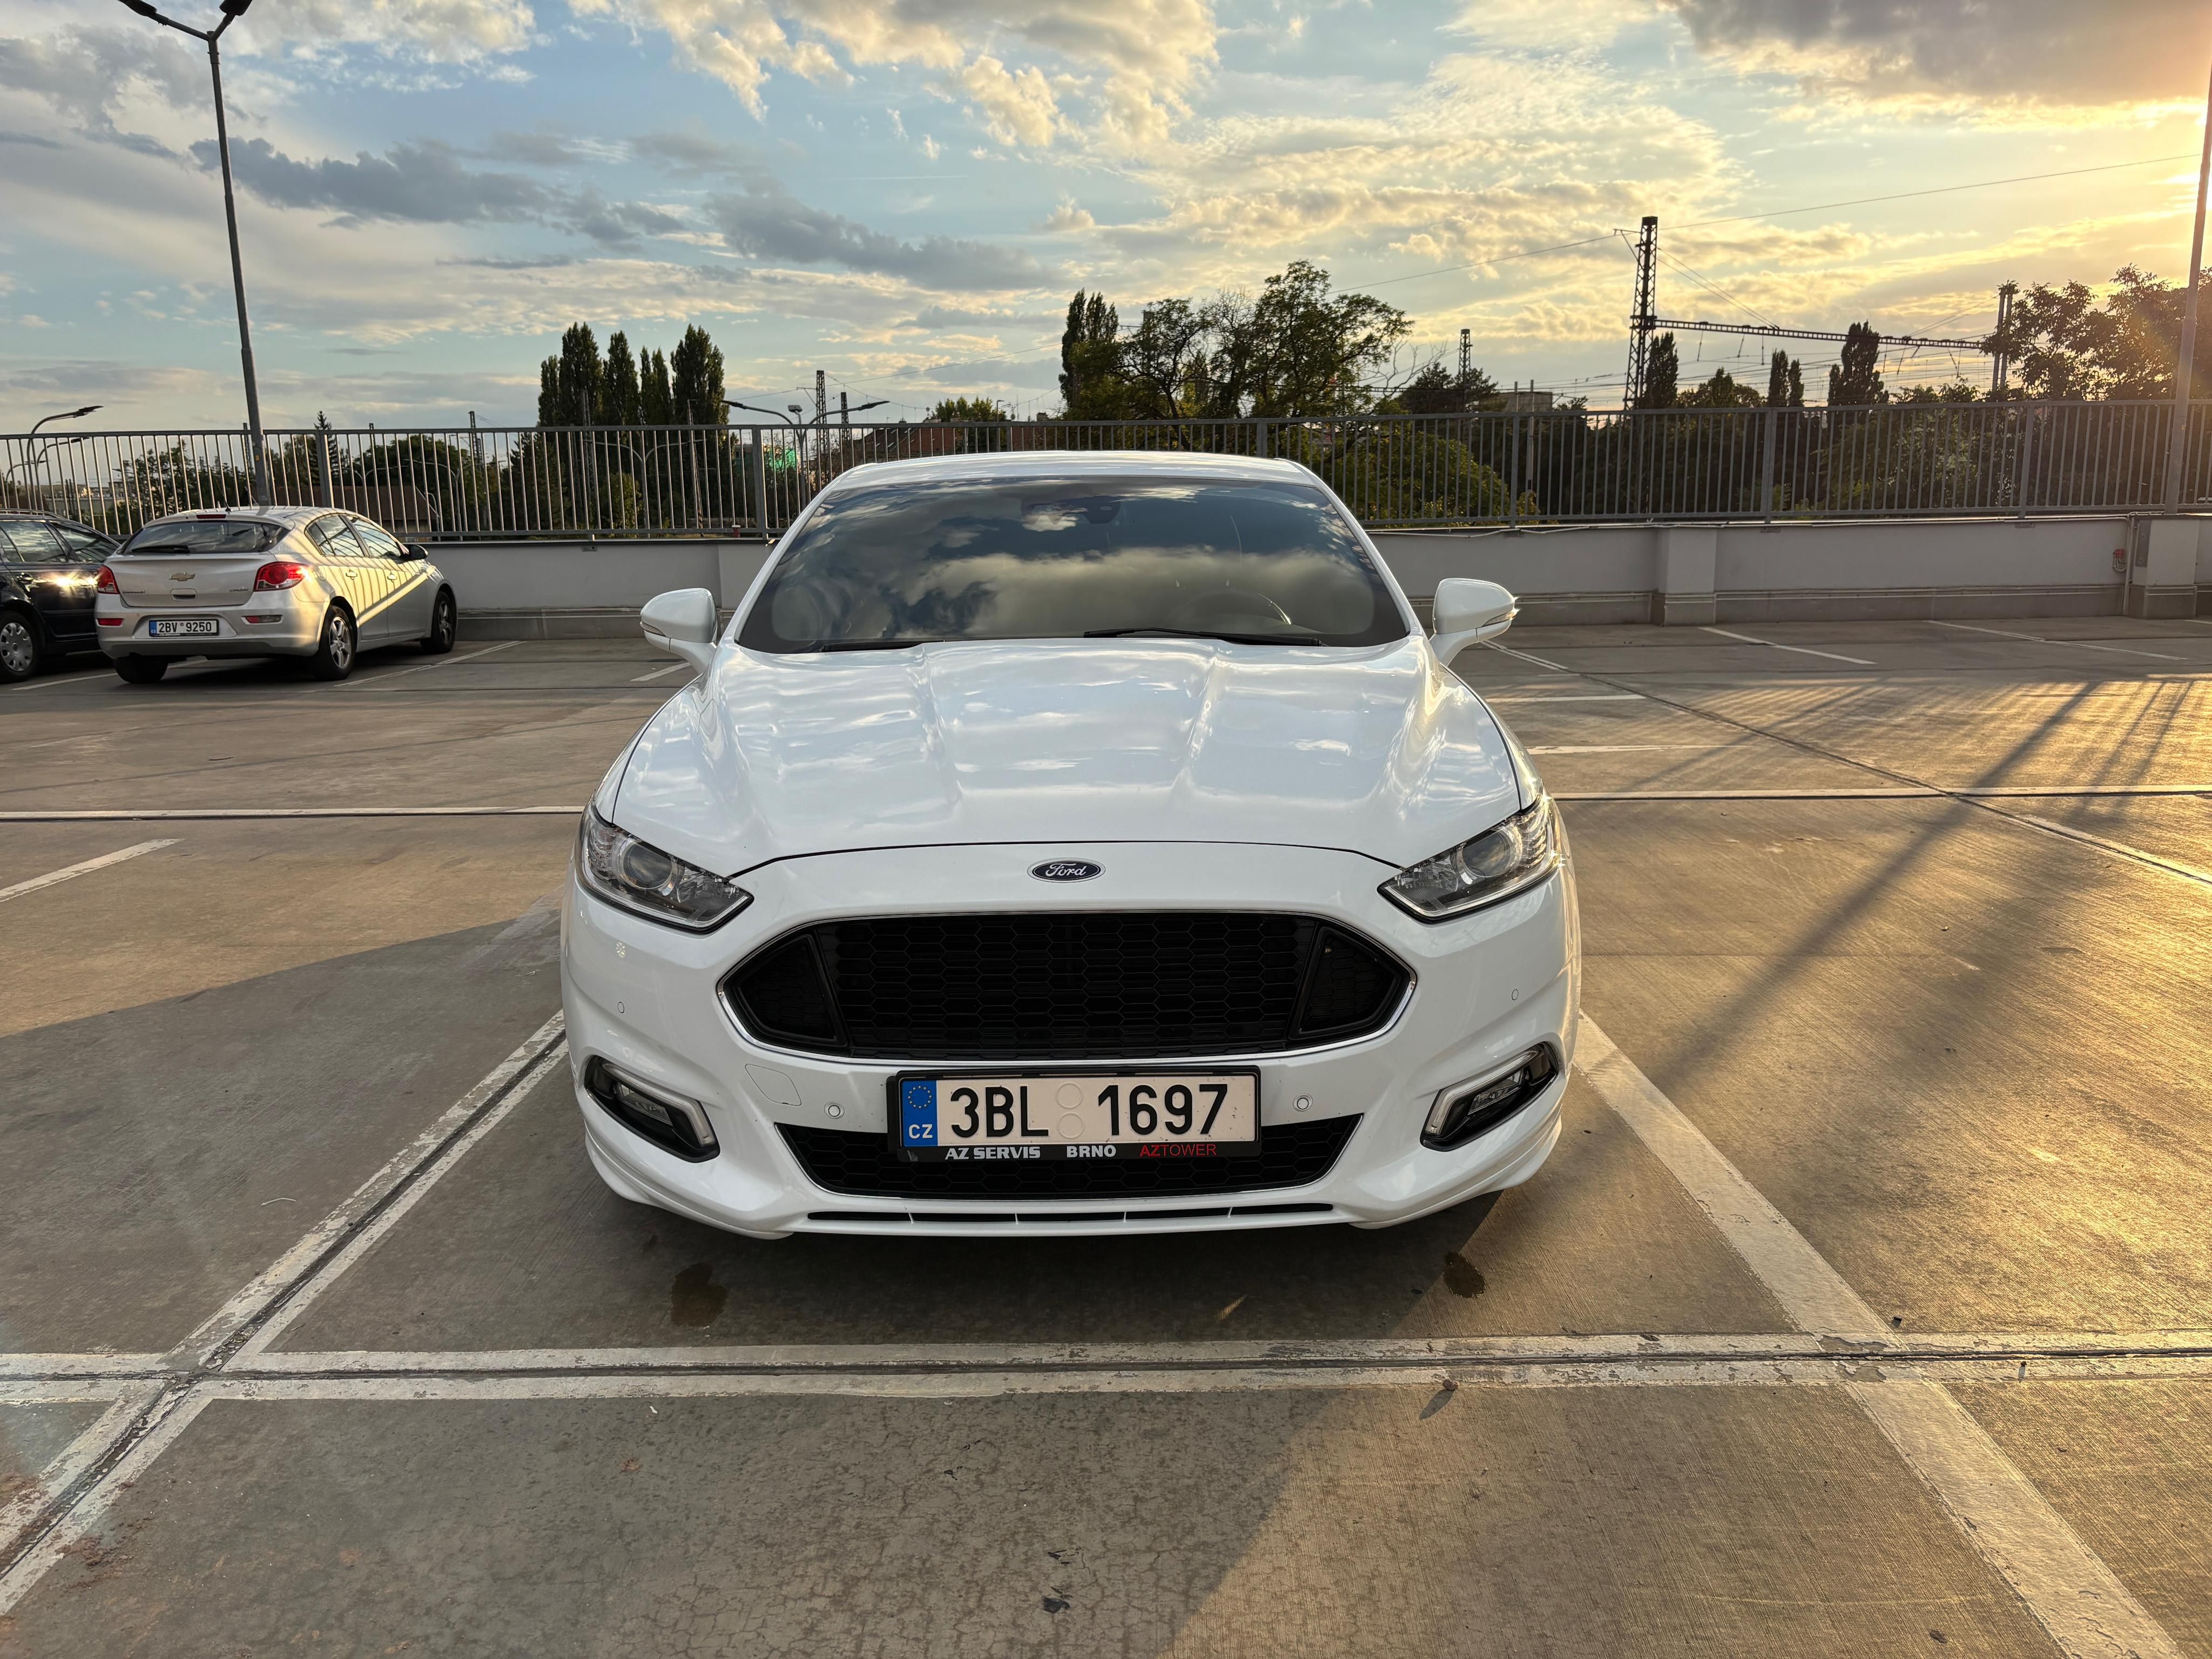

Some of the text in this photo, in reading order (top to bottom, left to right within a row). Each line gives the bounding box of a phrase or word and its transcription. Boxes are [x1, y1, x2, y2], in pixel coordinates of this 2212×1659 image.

[159, 622, 212, 632] 2BV 9250
[1045, 863, 1087, 876] Ford
[950, 1084, 1228, 1138] 3BL 1697
[909, 1124, 933, 1138] CZ
[945, 1144, 1217, 1159] AZ SERVIS BRNO AZTOWER
